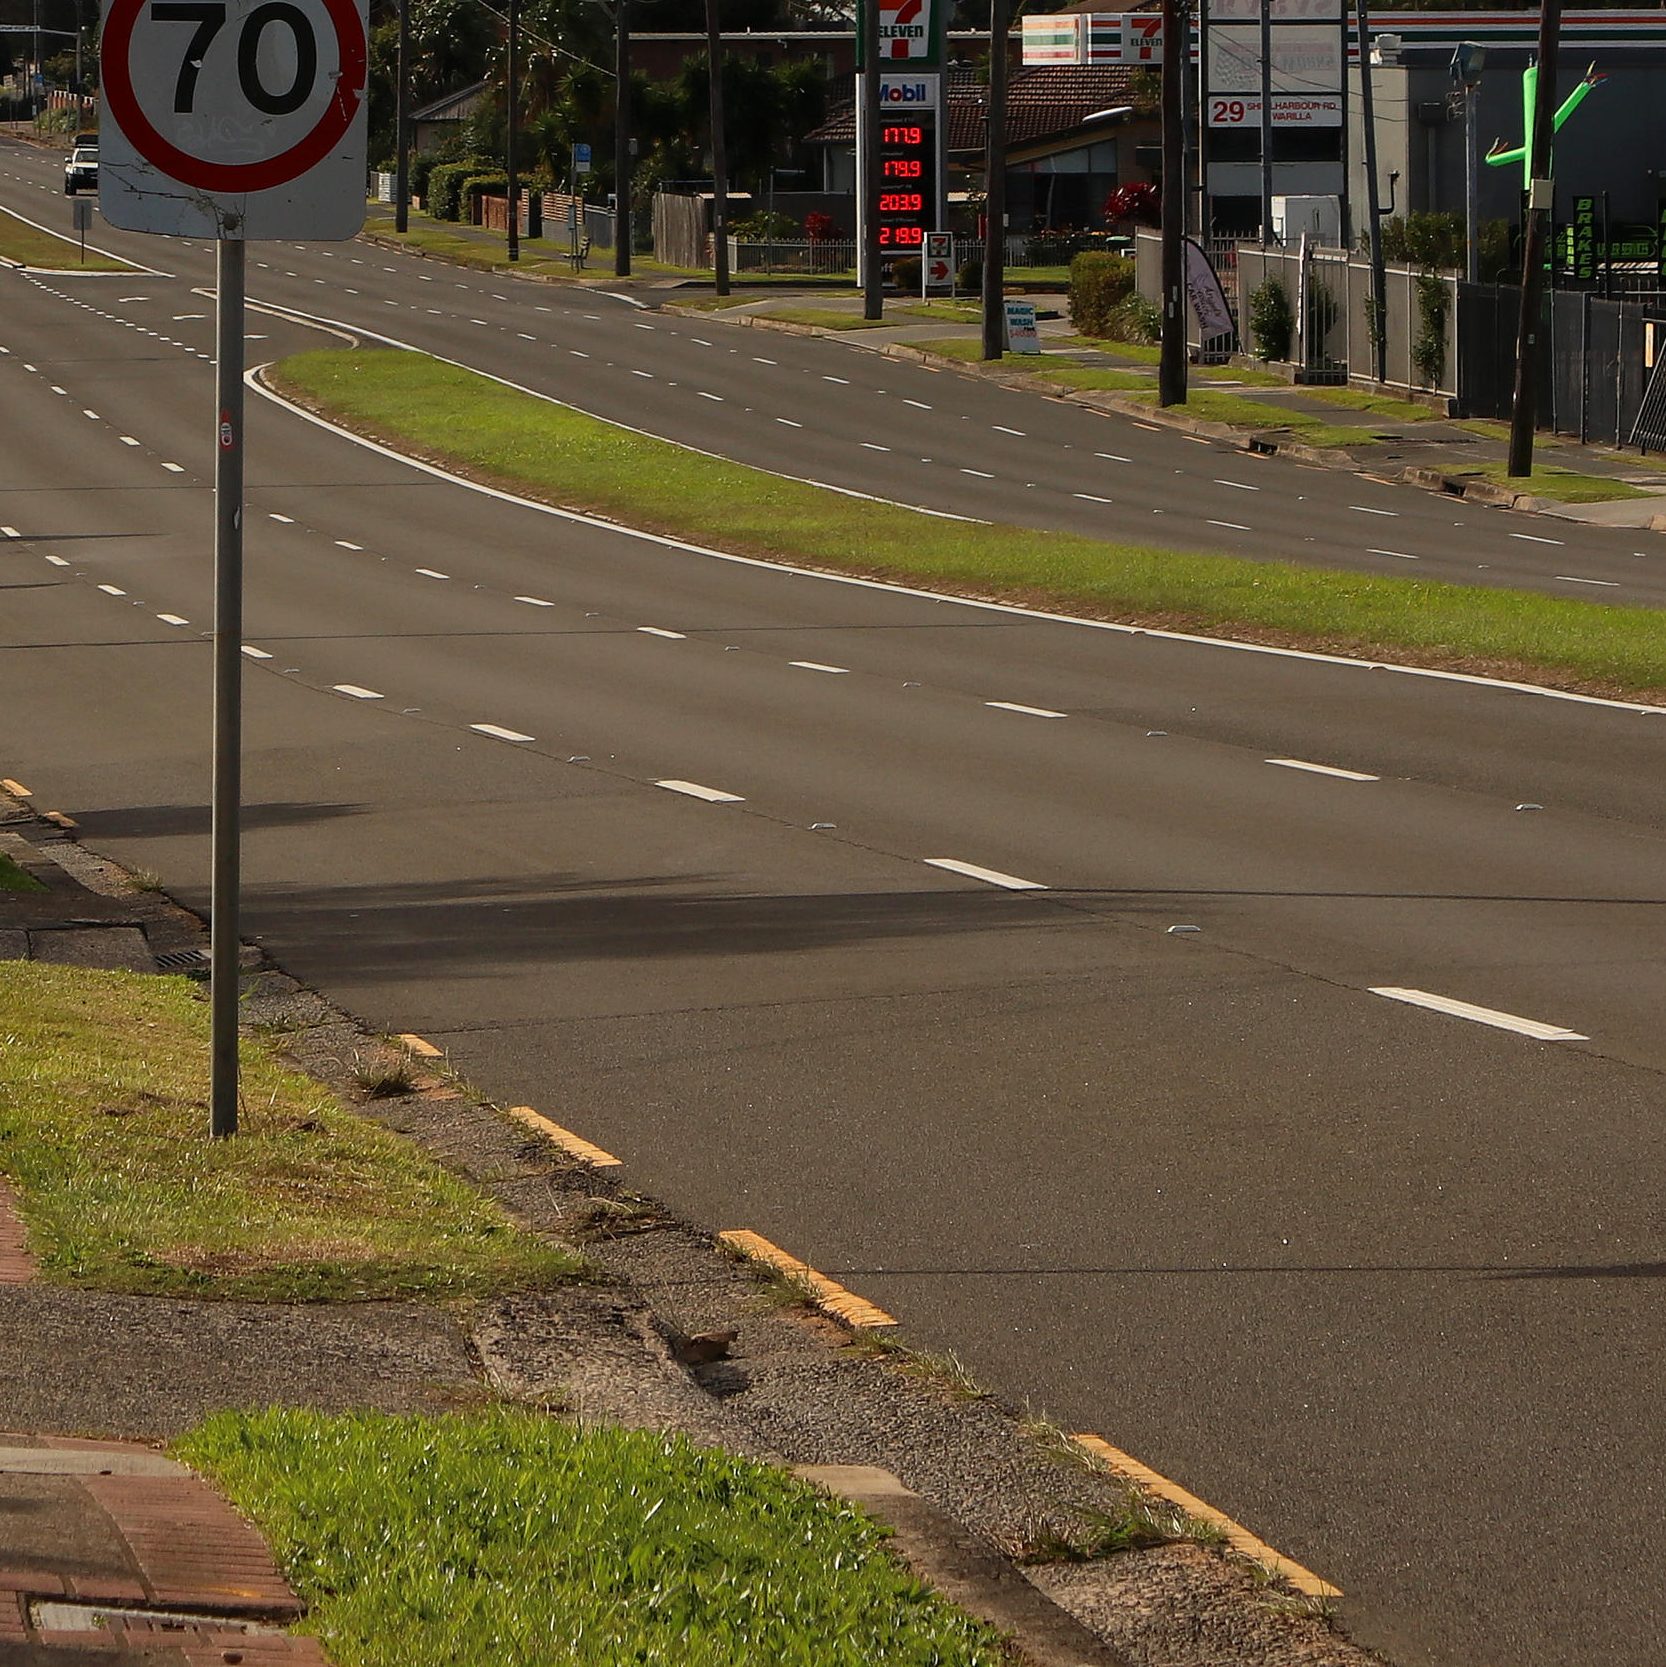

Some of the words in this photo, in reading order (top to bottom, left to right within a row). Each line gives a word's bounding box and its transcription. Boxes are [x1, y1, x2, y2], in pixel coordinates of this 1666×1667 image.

[1131, 18, 1162, 59] 7
[151, 1, 318, 116] 70
[1213, 101, 1245, 122] 29
[1247, 102, 1320, 110] SHHARBOUR
[1323, 102, 1336, 110] RD
[1273, 112, 1312, 121] WARILLA
[885, 128, 921, 144] 177.9
[885, 161, 921, 177] 179.9
[880, 194, 921, 211] 203.9
[880, 227, 921, 244] 219.9
[1577, 199, 1593, 278] BRAKES
